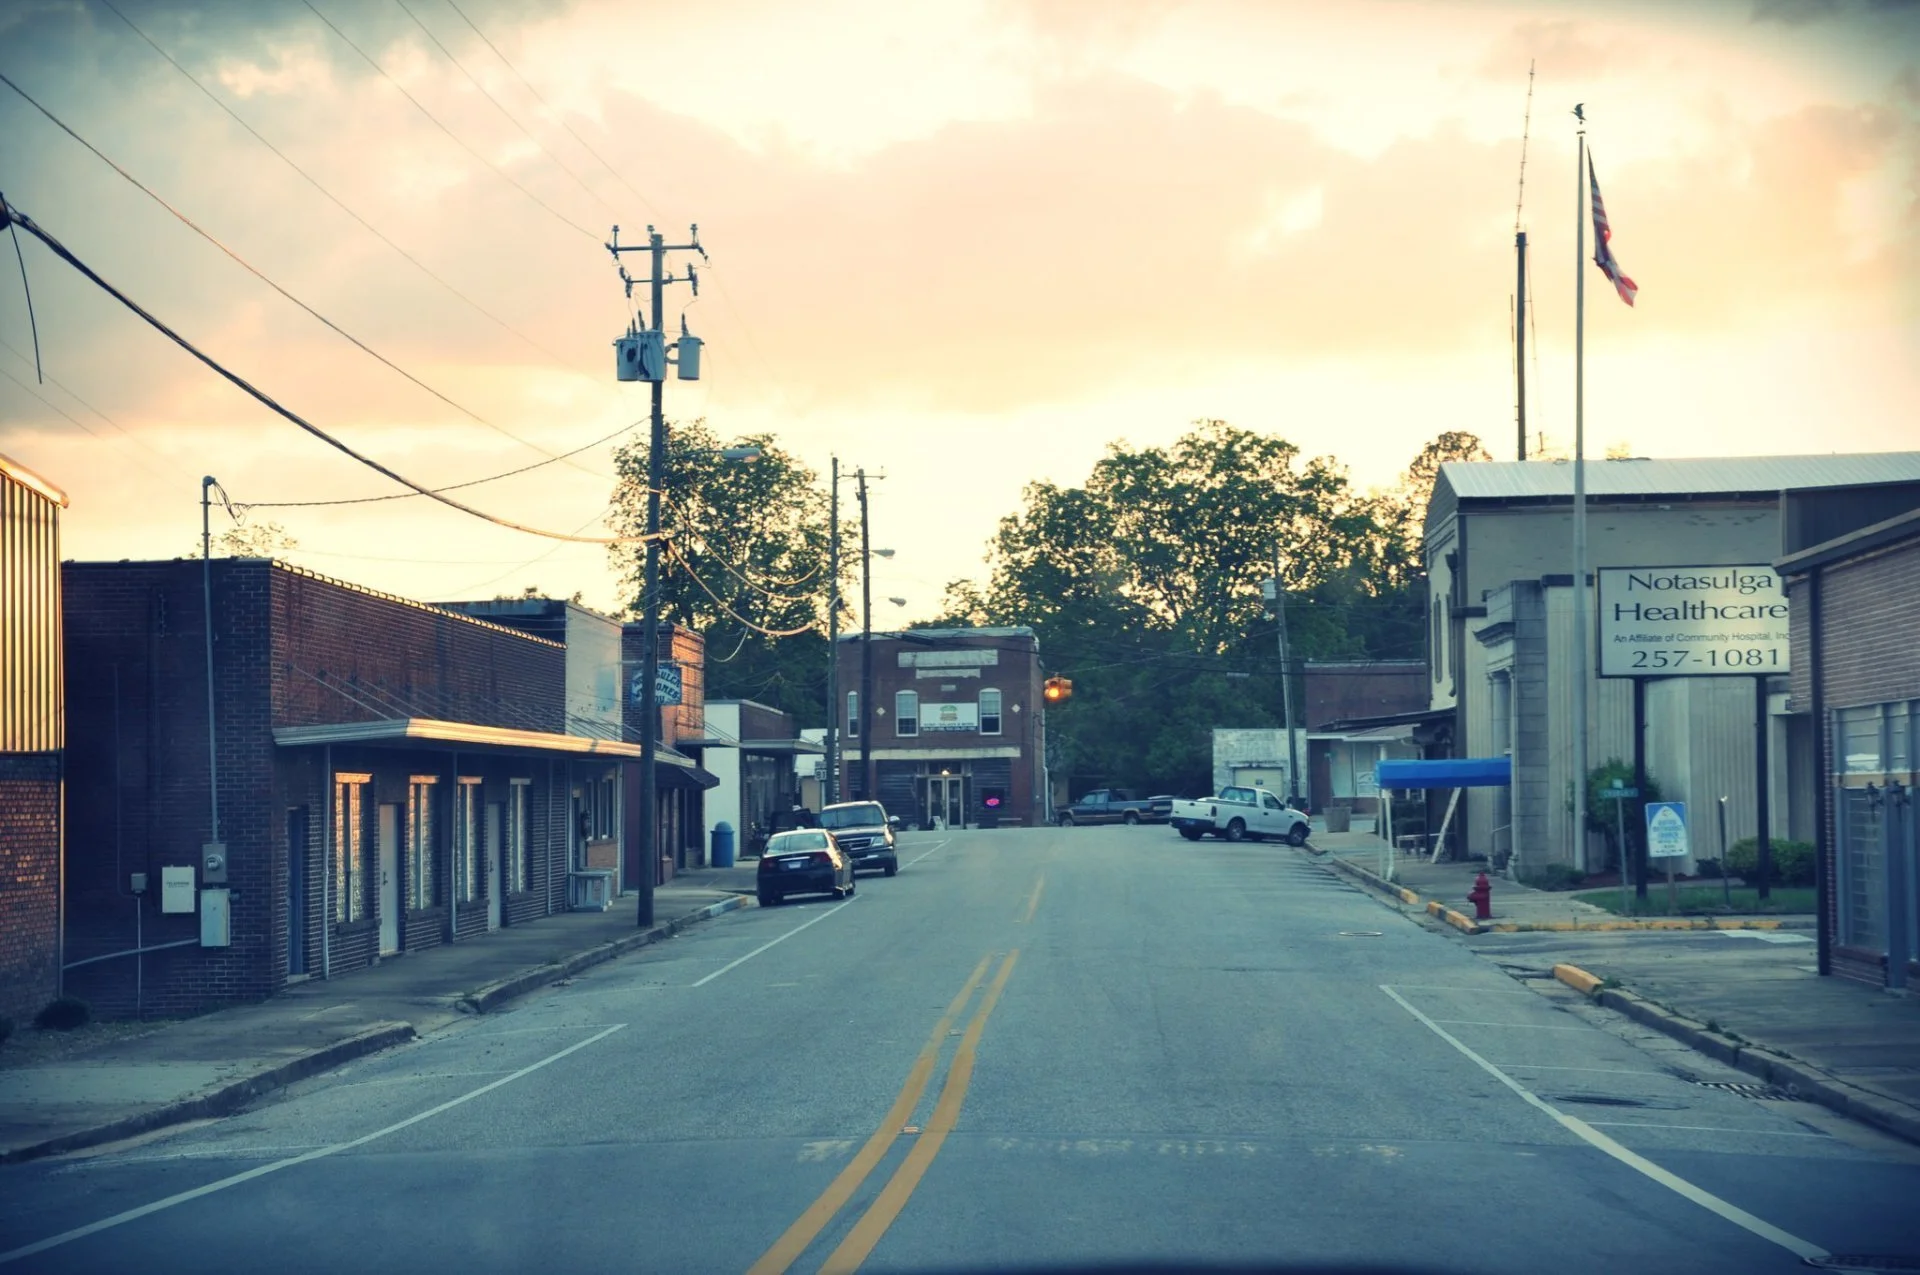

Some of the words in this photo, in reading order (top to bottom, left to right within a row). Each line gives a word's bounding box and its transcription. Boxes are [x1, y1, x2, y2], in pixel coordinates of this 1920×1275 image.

[1628, 569, 1773, 595] Notasulga
[1614, 600, 1789, 621] Healthcare
[1614, 634, 1627, 643] An
[1629, 634, 1662, 643] Affiliate
[1664, 633, 1674, 642] of
[1676, 633, 1729, 643] Community
[1631, 648, 1778, 668] 257-1081
